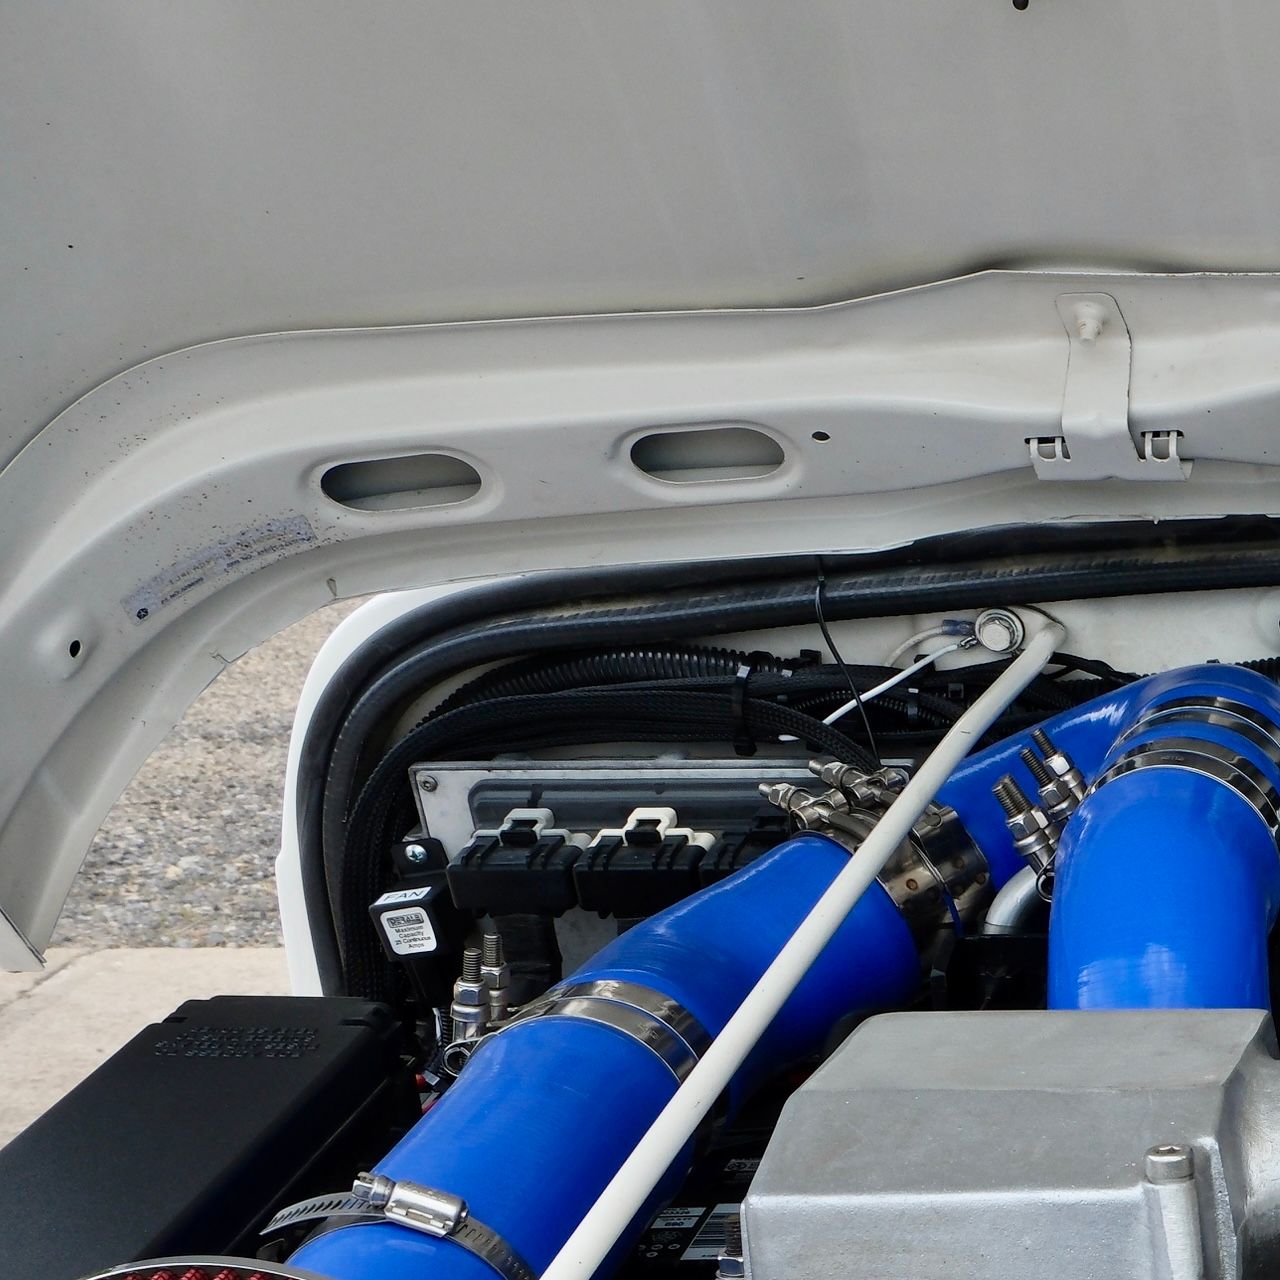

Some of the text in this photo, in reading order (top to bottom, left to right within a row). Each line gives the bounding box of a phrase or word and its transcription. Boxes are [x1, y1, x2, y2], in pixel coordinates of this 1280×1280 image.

[383, 889, 424, 901] FAN
[394, 925, 423, 934] Maximum
[398, 931, 424, 939] Capacity
[402, 936, 432, 945] Continuous
